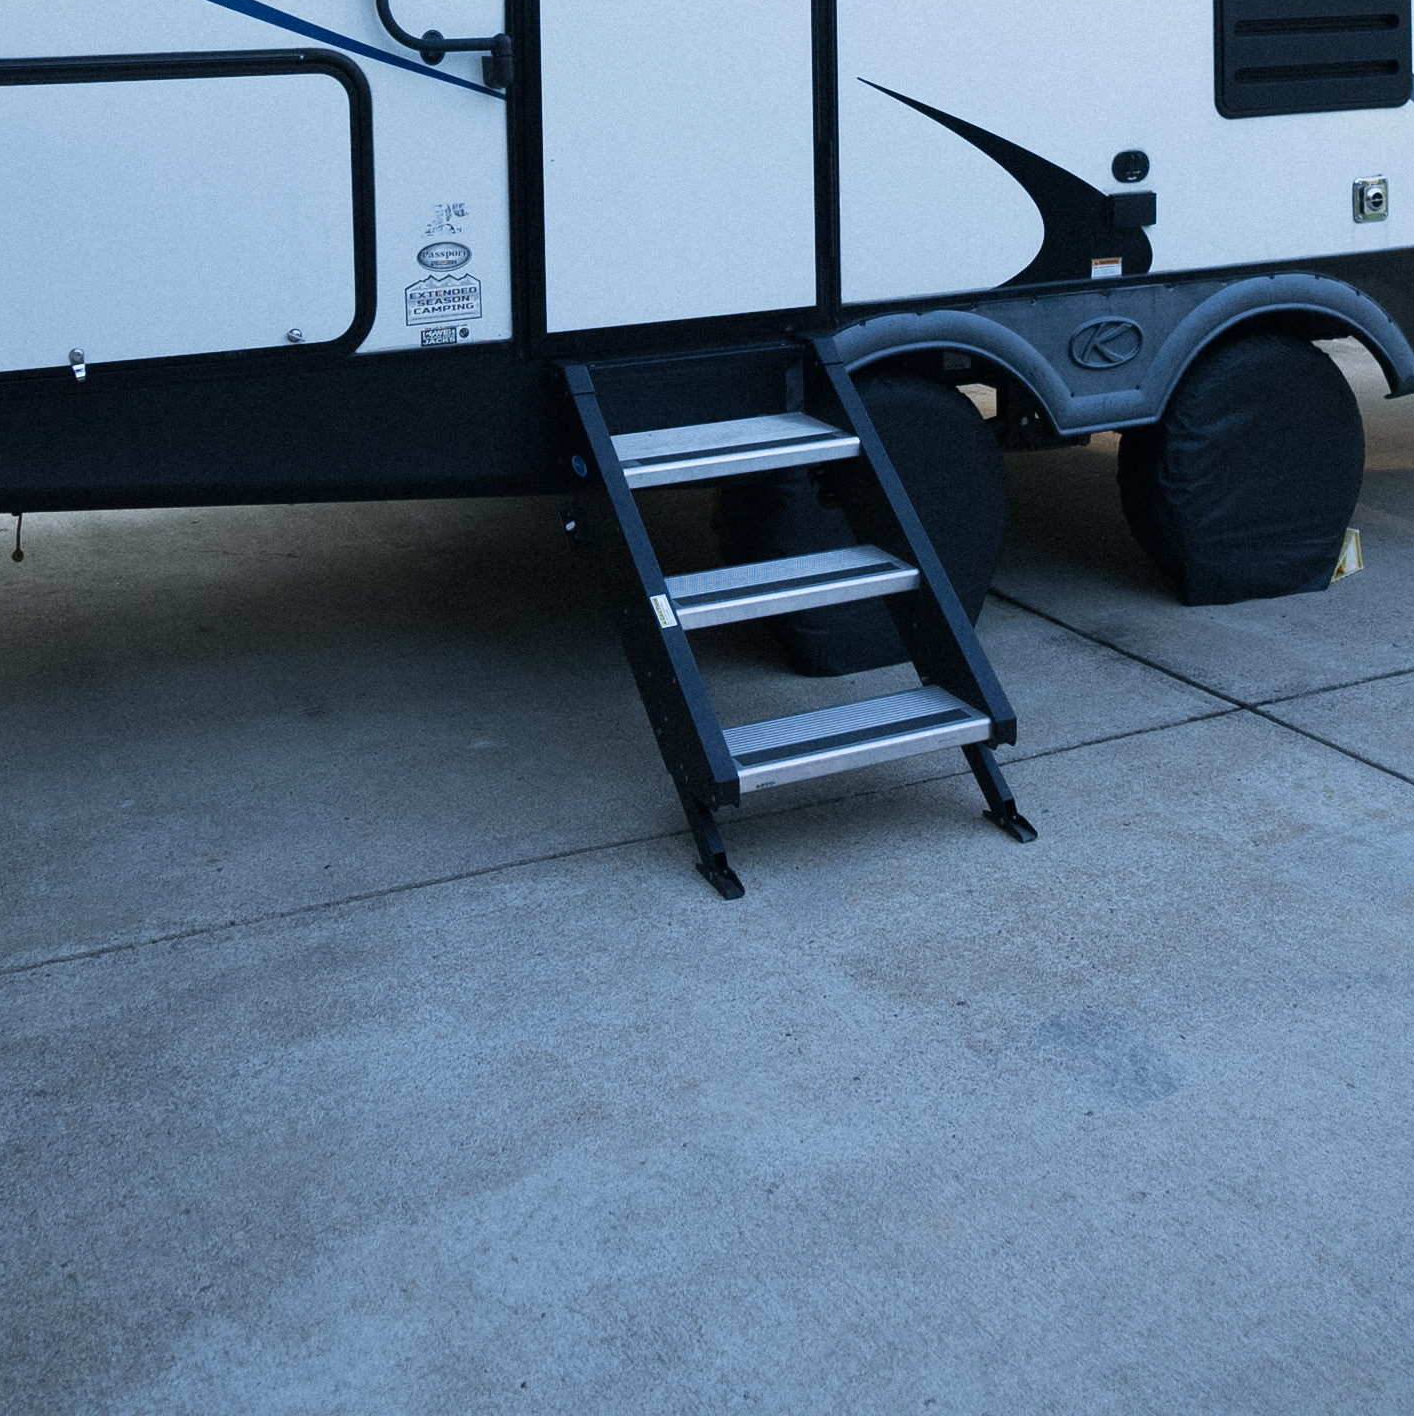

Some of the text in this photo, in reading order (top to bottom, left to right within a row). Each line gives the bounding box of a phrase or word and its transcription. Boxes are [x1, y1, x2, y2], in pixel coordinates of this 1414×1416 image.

[409, 286, 477, 300] EXTENDED
[417, 295, 470, 307] SEASON
[413, 303, 475, 315] CAMPING
